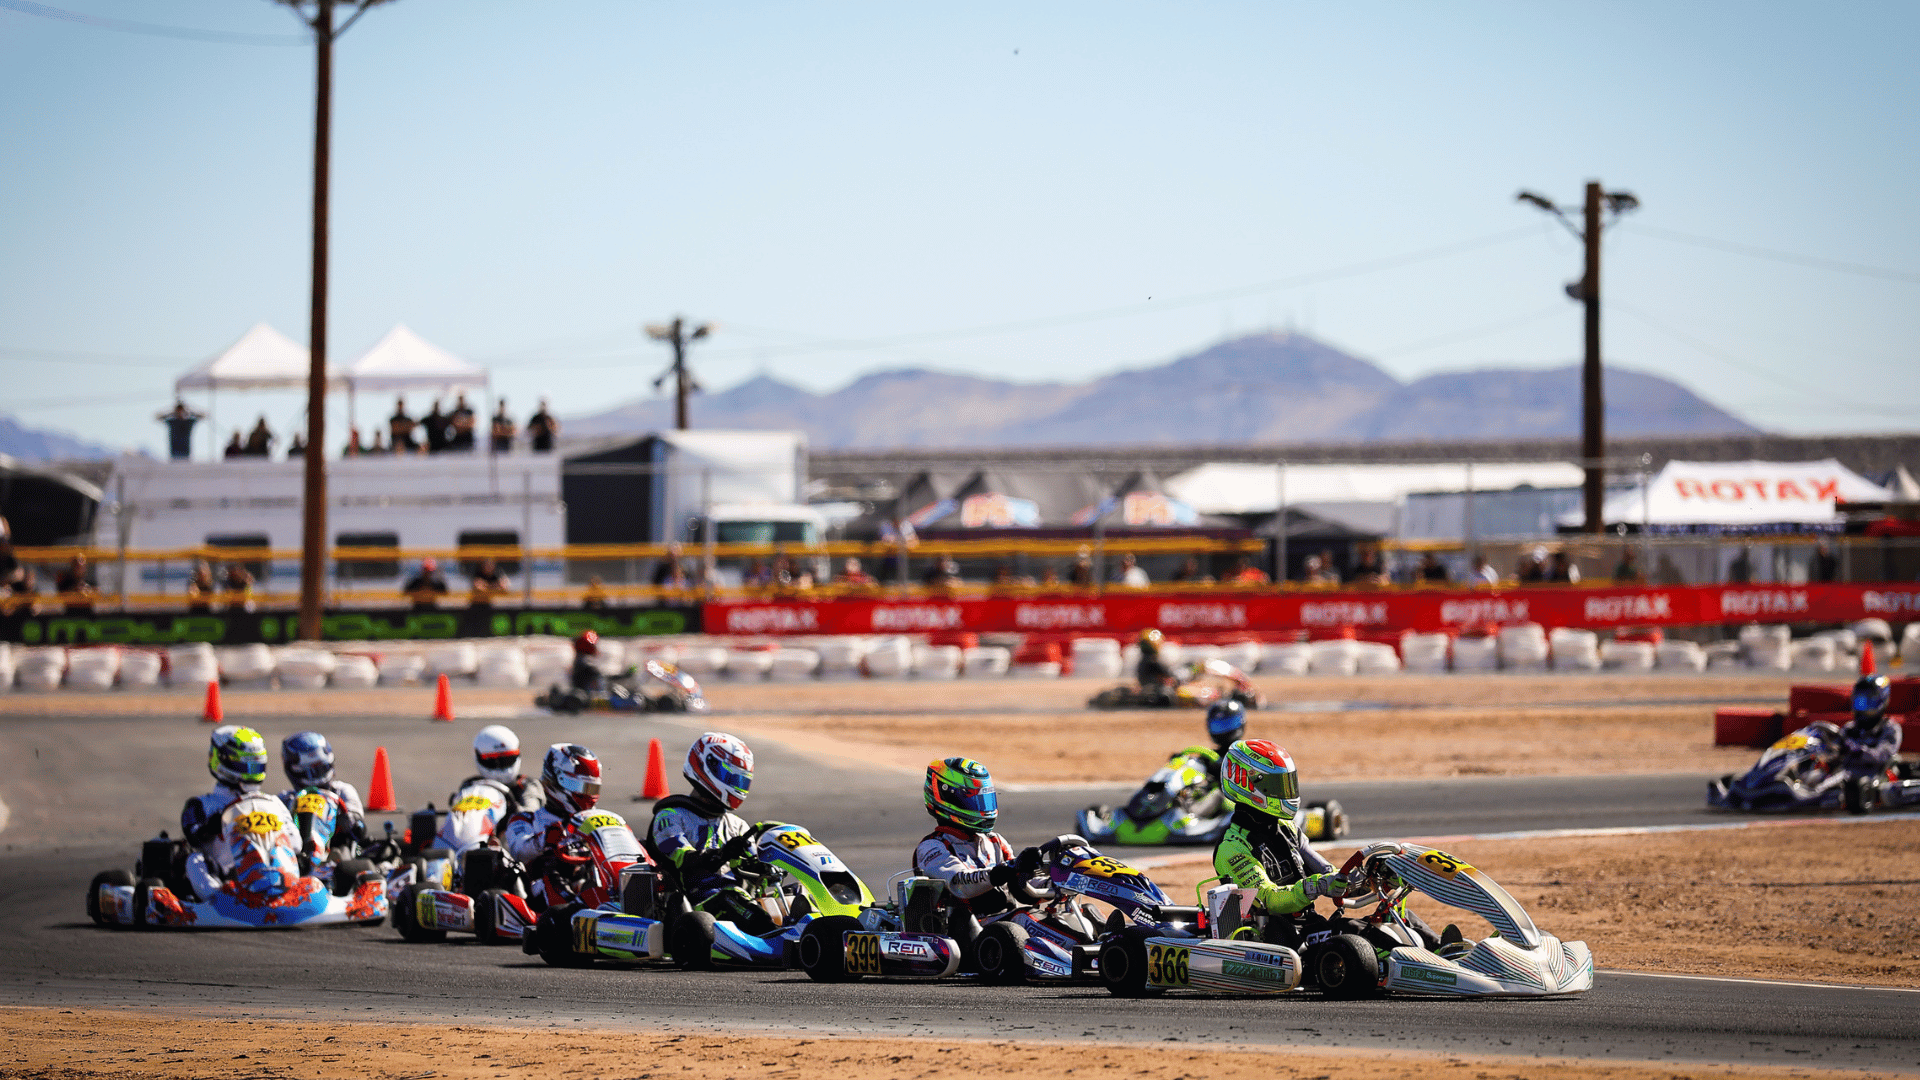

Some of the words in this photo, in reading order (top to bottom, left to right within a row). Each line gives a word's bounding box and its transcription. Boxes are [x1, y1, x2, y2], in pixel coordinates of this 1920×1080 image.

[848, 935, 880, 973] 399
[888, 942, 928, 957] REM
[1150, 945, 1189, 984] 366
